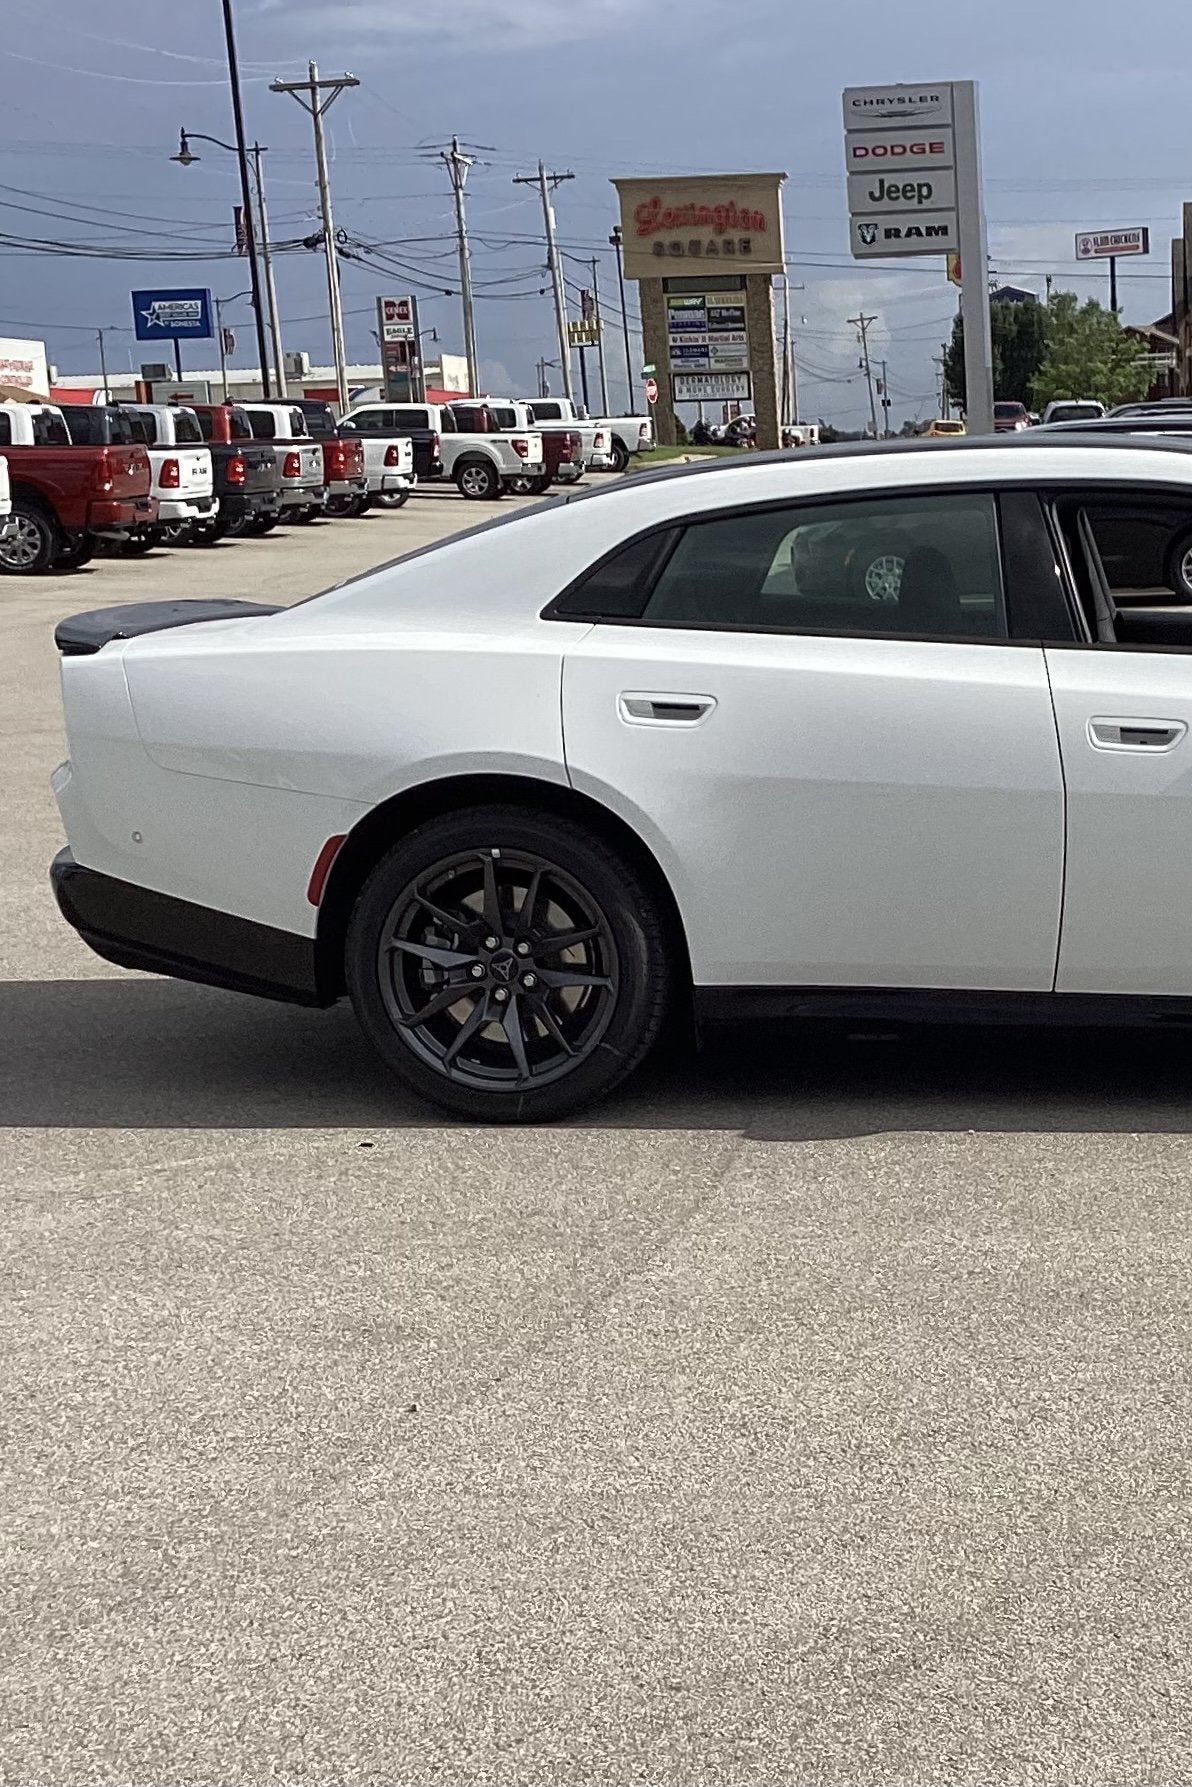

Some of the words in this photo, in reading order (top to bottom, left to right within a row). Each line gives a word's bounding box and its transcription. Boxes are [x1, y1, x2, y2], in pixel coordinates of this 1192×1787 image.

[852, 95, 940, 107] CHRYSLER
[852, 141, 945, 158] DODGE
[868, 178, 933, 205] Jeep
[884, 224, 949, 239] RAM
[652, 238, 752, 256] SQUARE
[385, 306, 408, 315] CENEX
[386, 327, 413, 335] EAGLE
[731, 333, 745, 342] Arts
[680, 375, 742, 385] DERMATOLOGY
